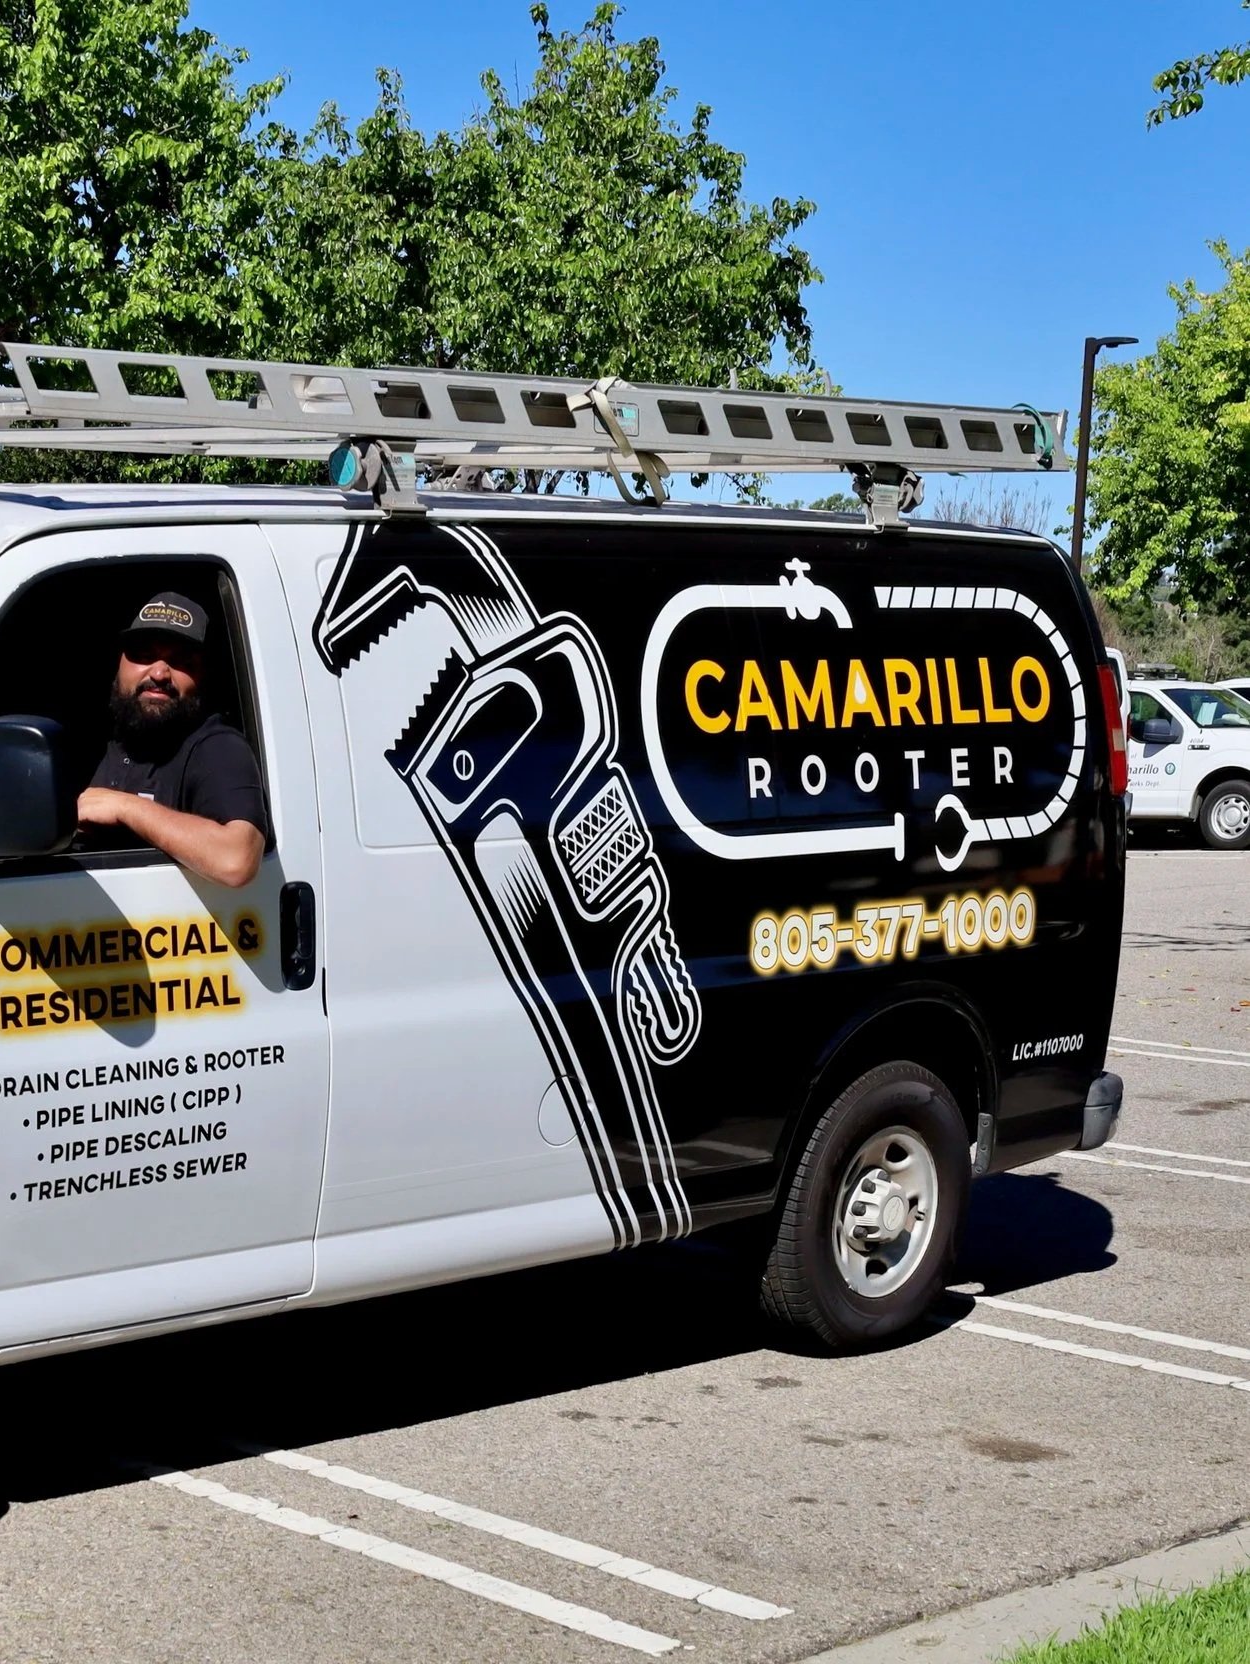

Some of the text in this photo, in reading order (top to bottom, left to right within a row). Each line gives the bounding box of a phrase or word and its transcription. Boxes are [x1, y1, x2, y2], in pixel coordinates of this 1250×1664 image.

[144, 608, 189, 621] CAMARILLO
[685, 656, 1050, 733] CAMARILLO
[748, 747, 1013, 798] ROOTER
[238, 918, 259, 951] &
[752, 890, 1035, 971] 805-377-1000
[1, 976, 239, 1028] RESIDENTIAL
[66, 1058, 178, 1089] CLEANING
[186, 1056, 197, 1074] &
[205, 1046, 284, 1072] ROOTER
[1013, 1034, 1083, 1060] LIC.#1107000
[37, 1106, 84, 1129] PIPE
[92, 1095, 164, 1122] LINING
[51, 1122, 226, 1163] PIPE DESCALING
[24, 1153, 247, 1202] TRENCHLESS SEWER
